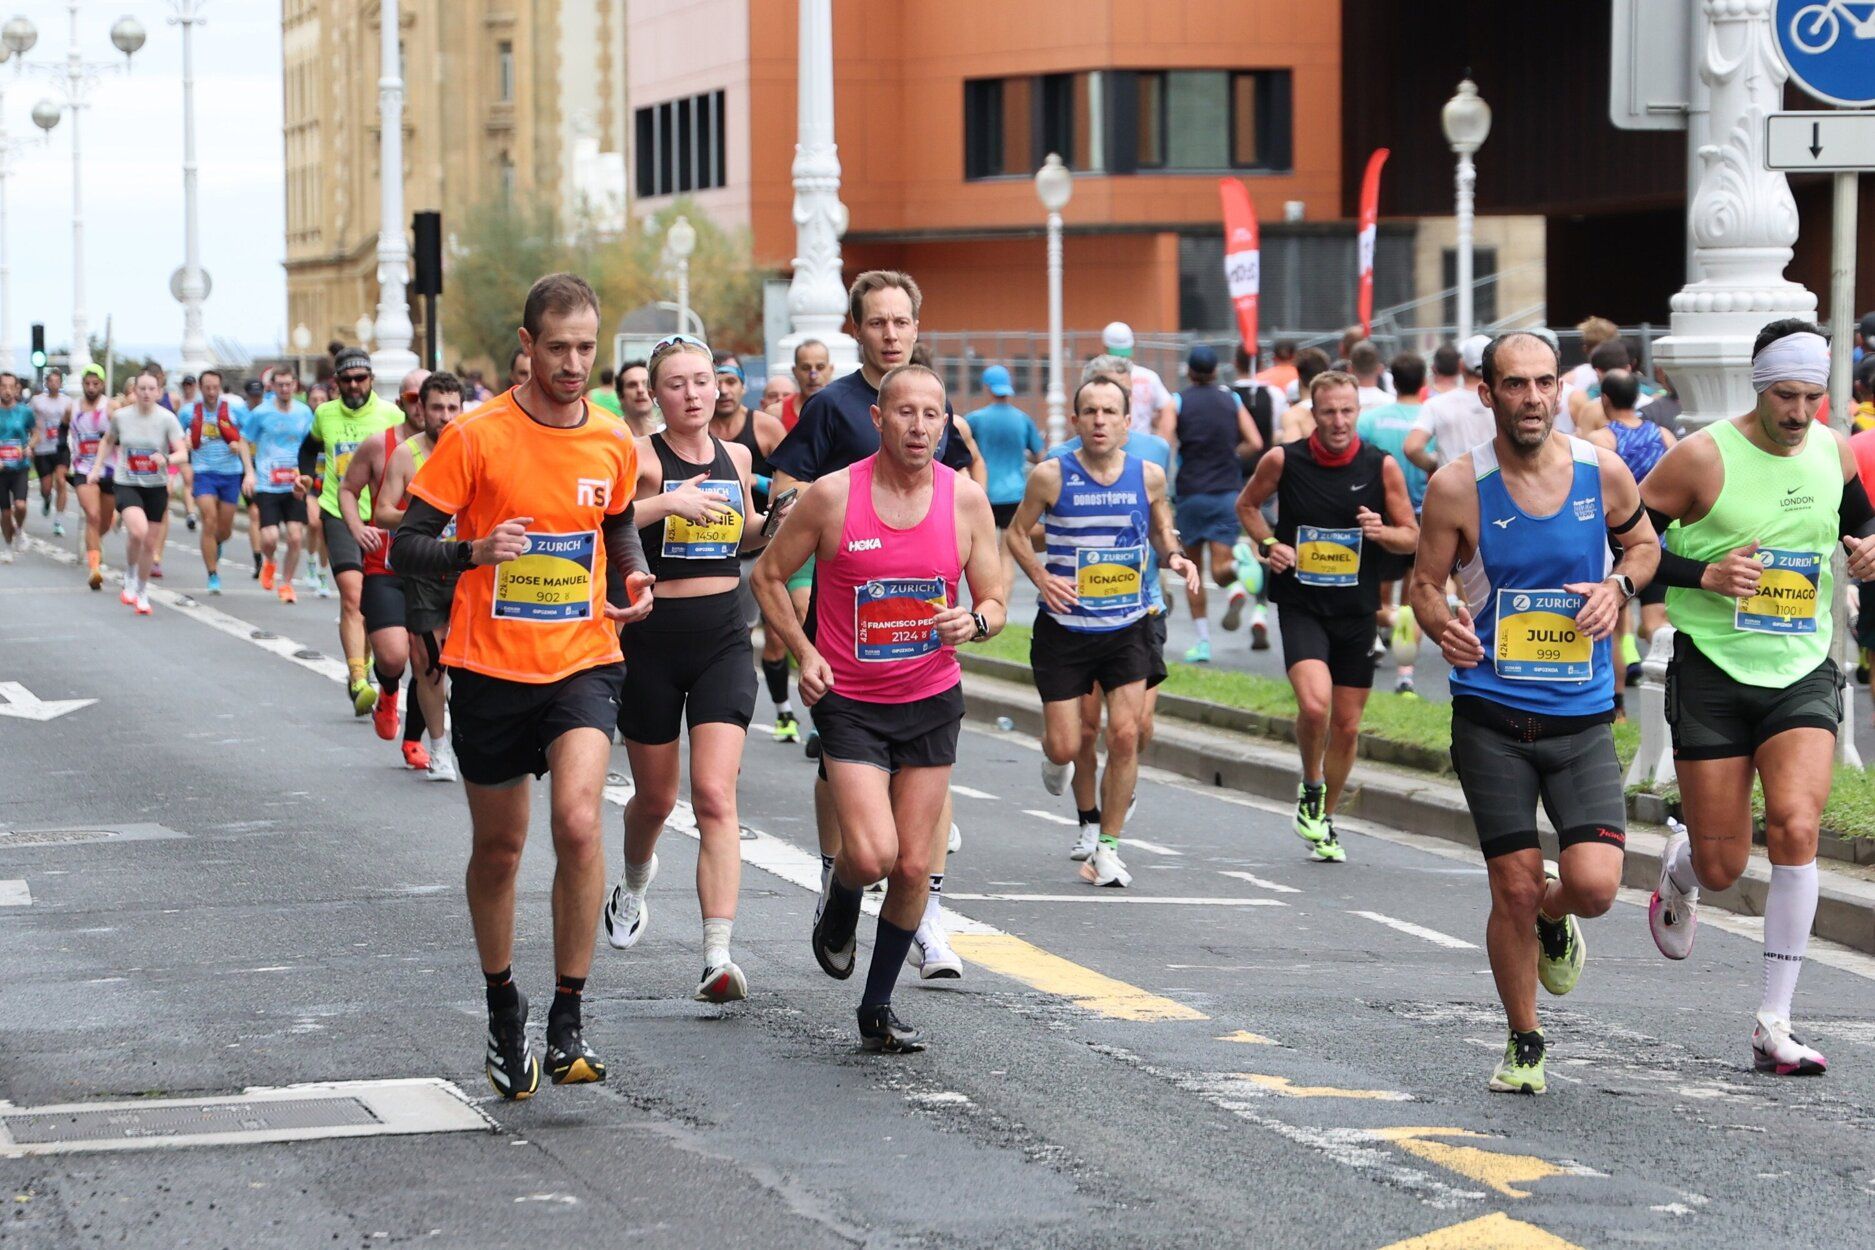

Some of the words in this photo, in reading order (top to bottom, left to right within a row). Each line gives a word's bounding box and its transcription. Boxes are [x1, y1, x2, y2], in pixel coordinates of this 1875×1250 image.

[699, 487, 730, 497] URICH
[1780, 496, 1815, 507] LONDON
[696, 531, 719, 541] 1450
[1320, 532, 1351, 540] ZURICH
[537, 540, 581, 552] ZURICH
[848, 537, 882, 552] HOKA
[1102, 552, 1135, 561] ZURICH
[1311, 552, 1352, 562] DANIEL
[1780, 556, 1812, 567] ZURICH
[509, 574, 540, 586] JOSE
[543, 575, 588, 587] MANUEL
[1089, 573, 1136, 585] IGNACIO
[500, 583, 508, 599] 42k
[889, 584, 936, 594] ZURICH
[1755, 586, 1816, 600] SANTIAGO
[536, 591, 560, 603] 902
[1535, 598, 1581, 608] ZURICH
[1775, 604, 1797, 616] 1100
[868, 620, 916, 629] FRANCISCO
[918, 618, 936, 626] PED
[891, 631, 918, 642] 2124
[1526, 629, 1576, 643] JULIO
[1500, 643, 1508, 658] 42k
[1537, 649, 1561, 660] 999
